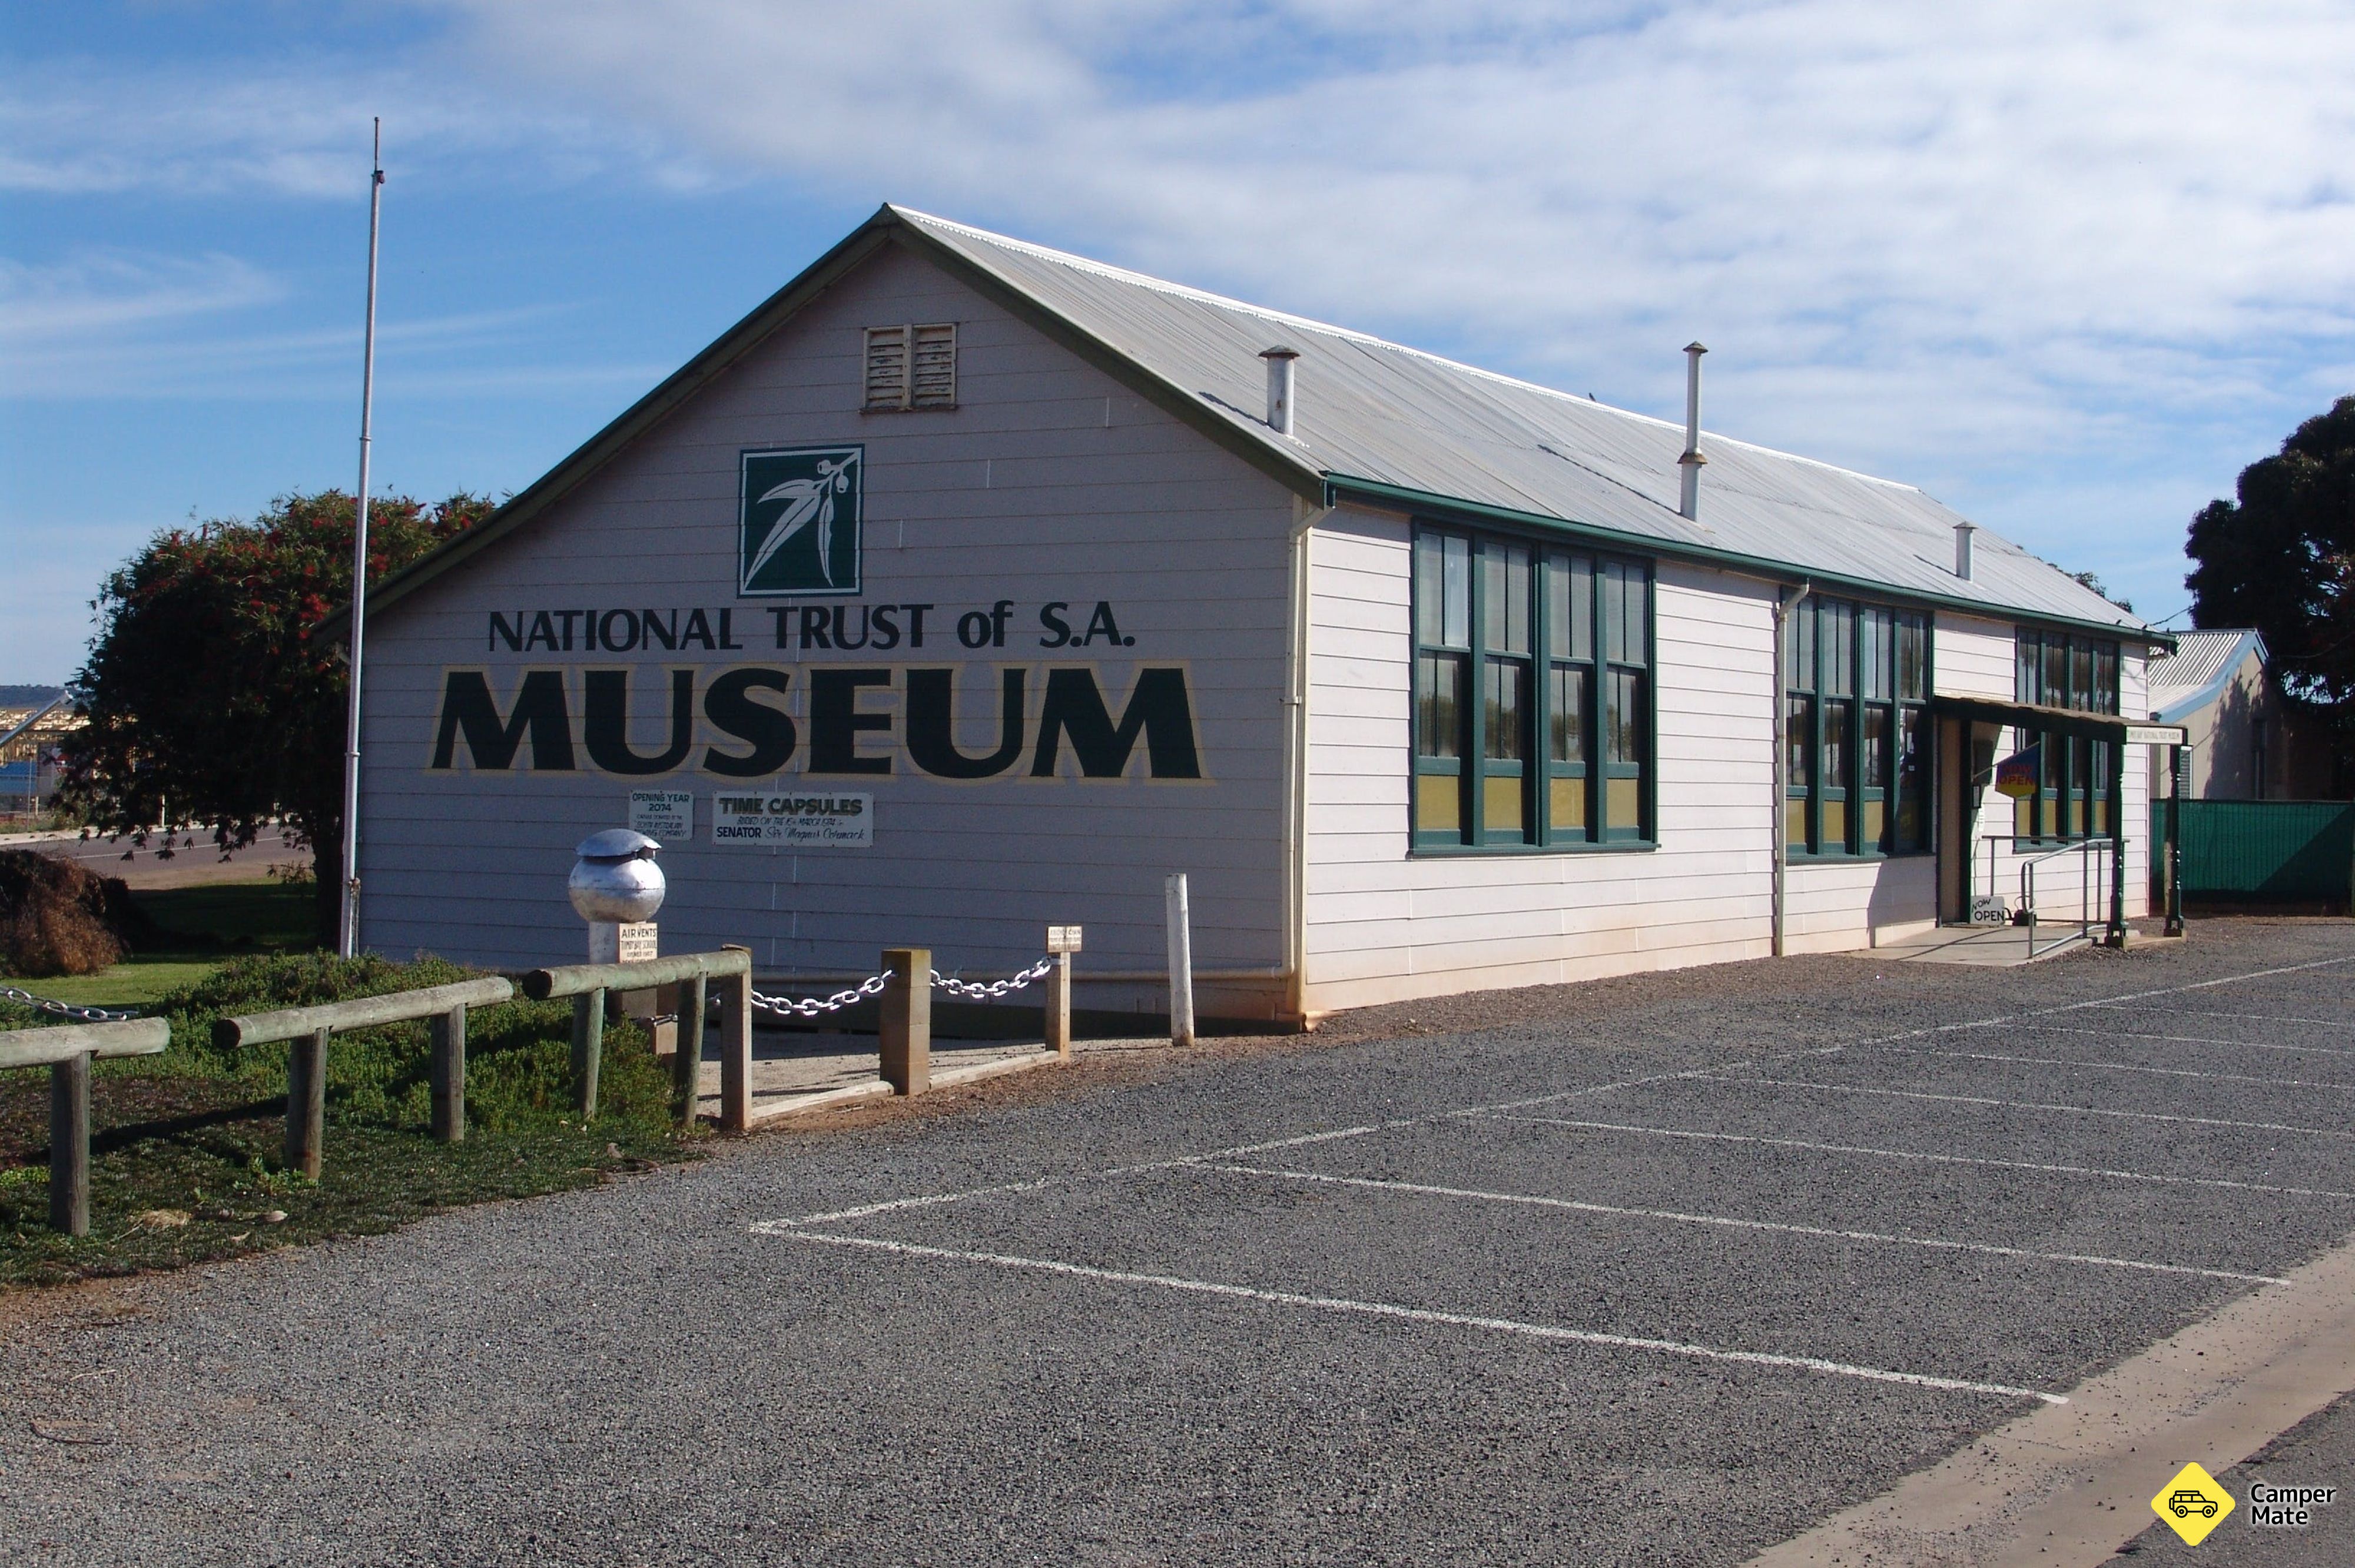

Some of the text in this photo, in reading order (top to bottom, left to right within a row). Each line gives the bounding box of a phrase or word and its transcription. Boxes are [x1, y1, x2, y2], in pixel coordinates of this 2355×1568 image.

[489, 600, 1136, 652] NATIONAL TRUST of S.A.
[430, 666, 1203, 780] MUSEUM
[2002, 765, 2032, 775] NOW
[1999, 775, 2034, 786] OPEN
[632, 793, 689, 802] OPENING YEAR
[649, 803, 672, 812] 2074
[719, 798, 863, 816] TIME CAPSULES
[717, 826, 761, 838] SENATOR
[784, 827, 820, 842] Magnus
[1971, 898, 1991, 913] NOW
[1974, 911, 2005, 921] OPEN
[622, 928, 656, 938] AIR VENTS
